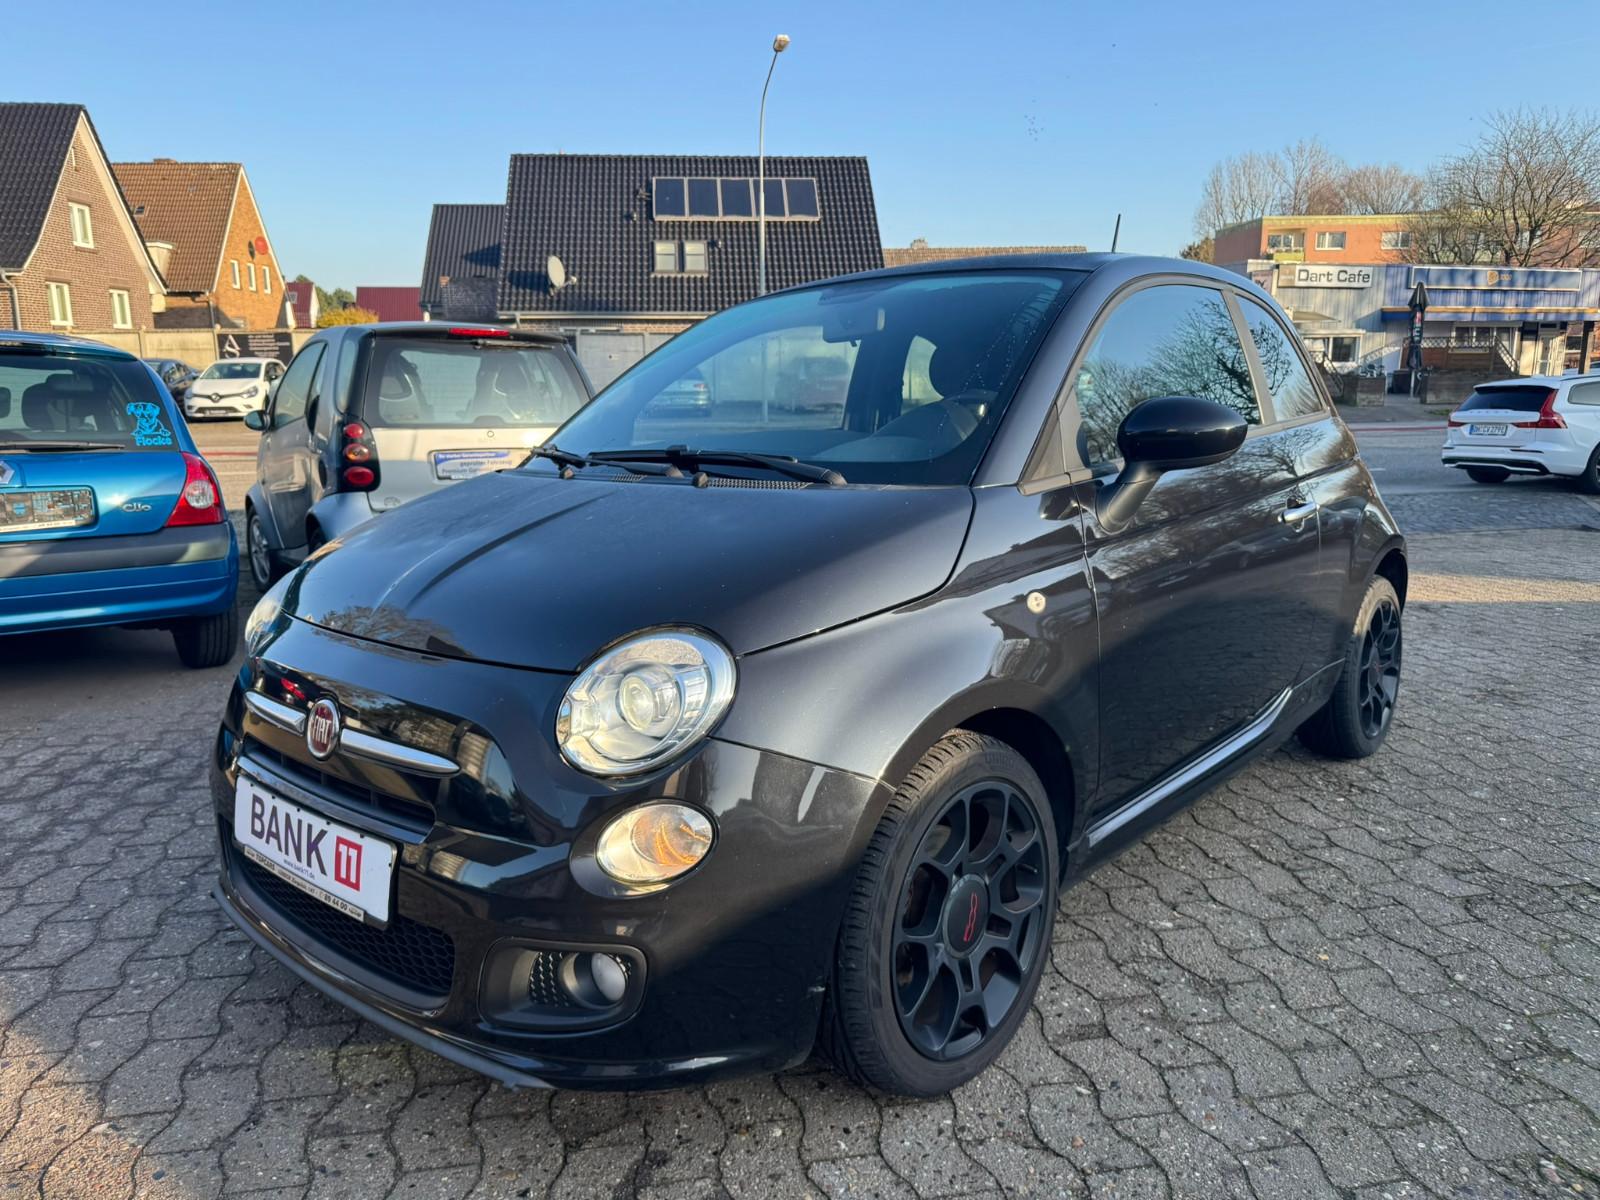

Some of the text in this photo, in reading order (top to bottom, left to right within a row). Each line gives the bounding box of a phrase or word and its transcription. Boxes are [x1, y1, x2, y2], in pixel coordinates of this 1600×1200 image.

[1298, 269, 1371, 283] Dart Cafe
[122, 502, 152, 512] Clio
[311, 714, 332, 744] FIAT
[251, 794, 327, 876] BANK
